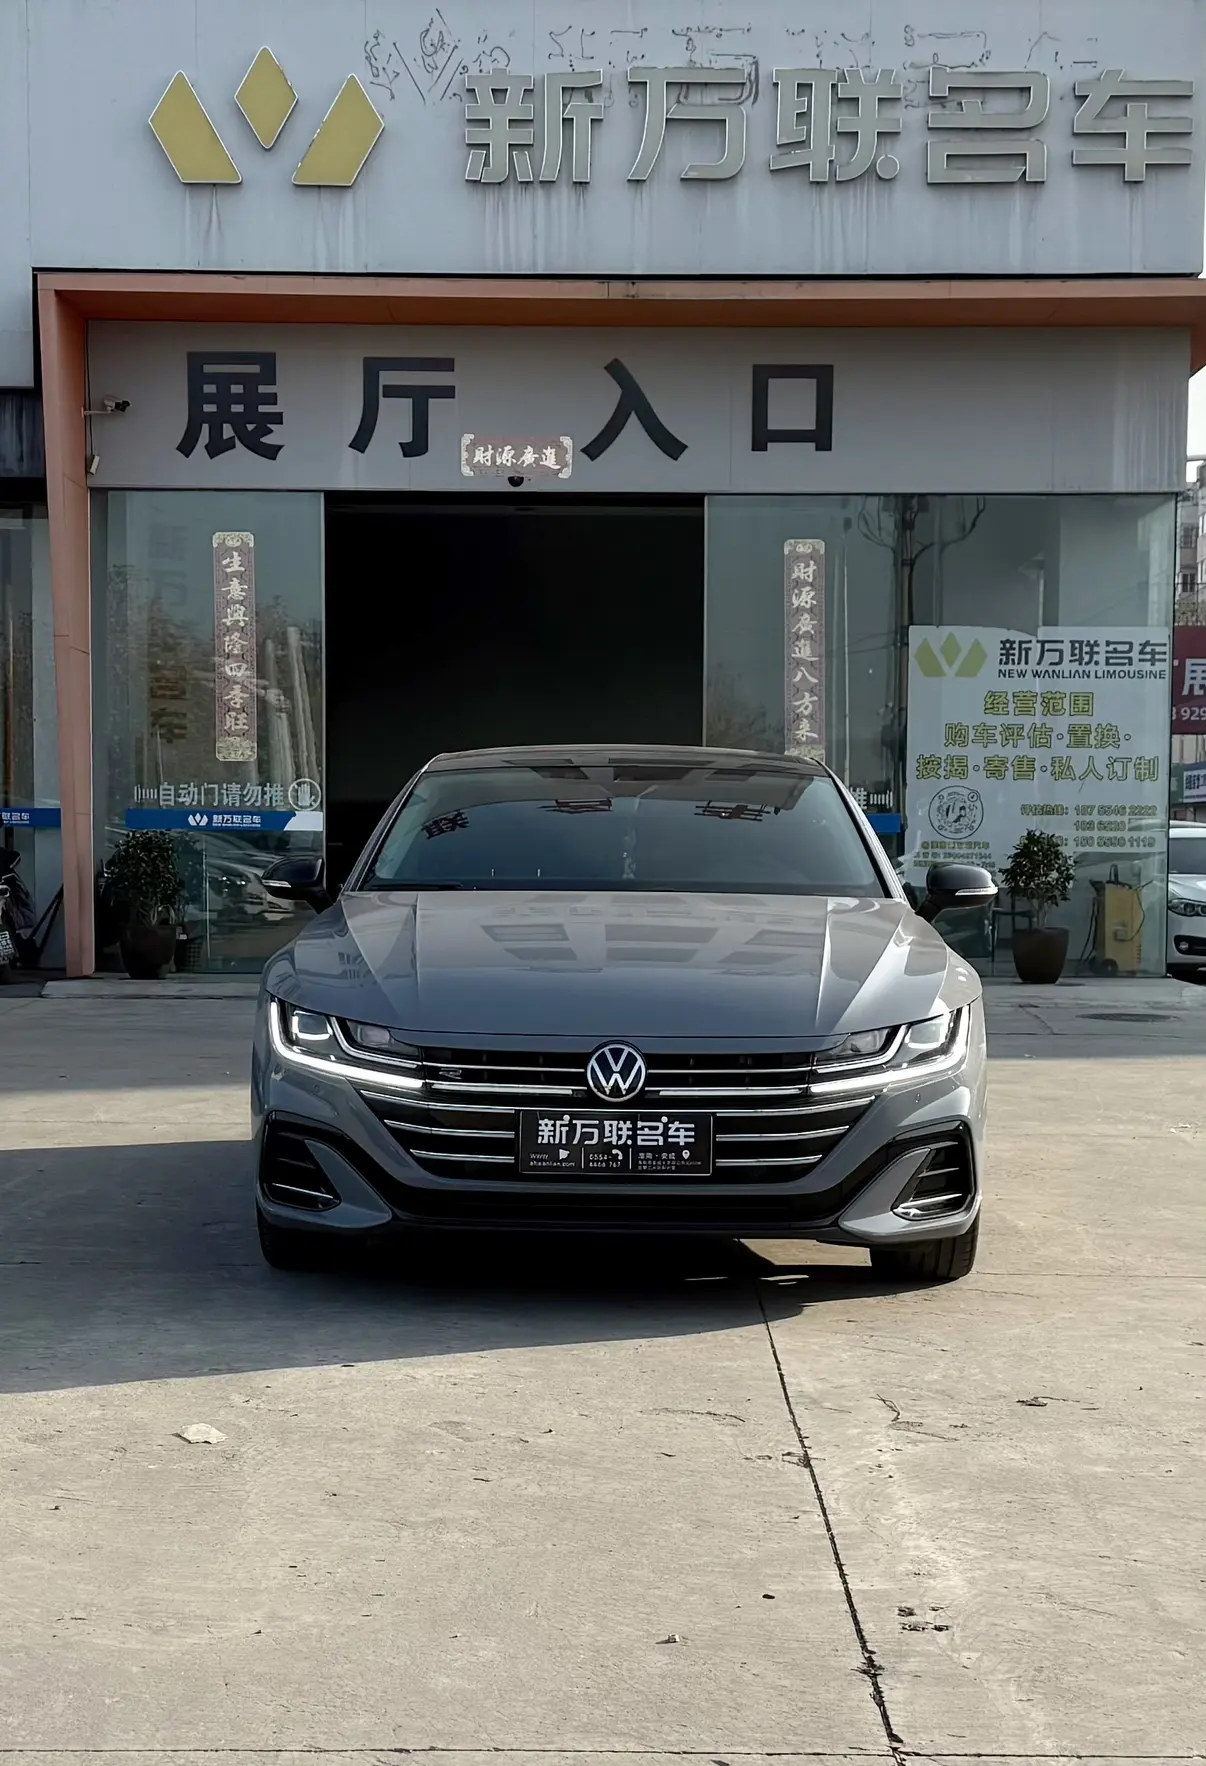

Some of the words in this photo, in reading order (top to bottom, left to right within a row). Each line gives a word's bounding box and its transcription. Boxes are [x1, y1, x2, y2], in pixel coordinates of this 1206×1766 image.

[464, 67, 1194, 185] 新万联名车
[176, 350, 834, 461] 展厅入口
[999, 639, 1168, 667] 新万联名车
[998, 668, 1028, 679] NEW
[1032, 668, 1091, 680] WANLIAN
[1094, 668, 1167, 680] LIMOUSINE
[983, 690, 1095, 717] 经营范围
[159, 781, 284, 807] 自动门请勿推
[537, 1118, 696, 1146] 新万联名车
